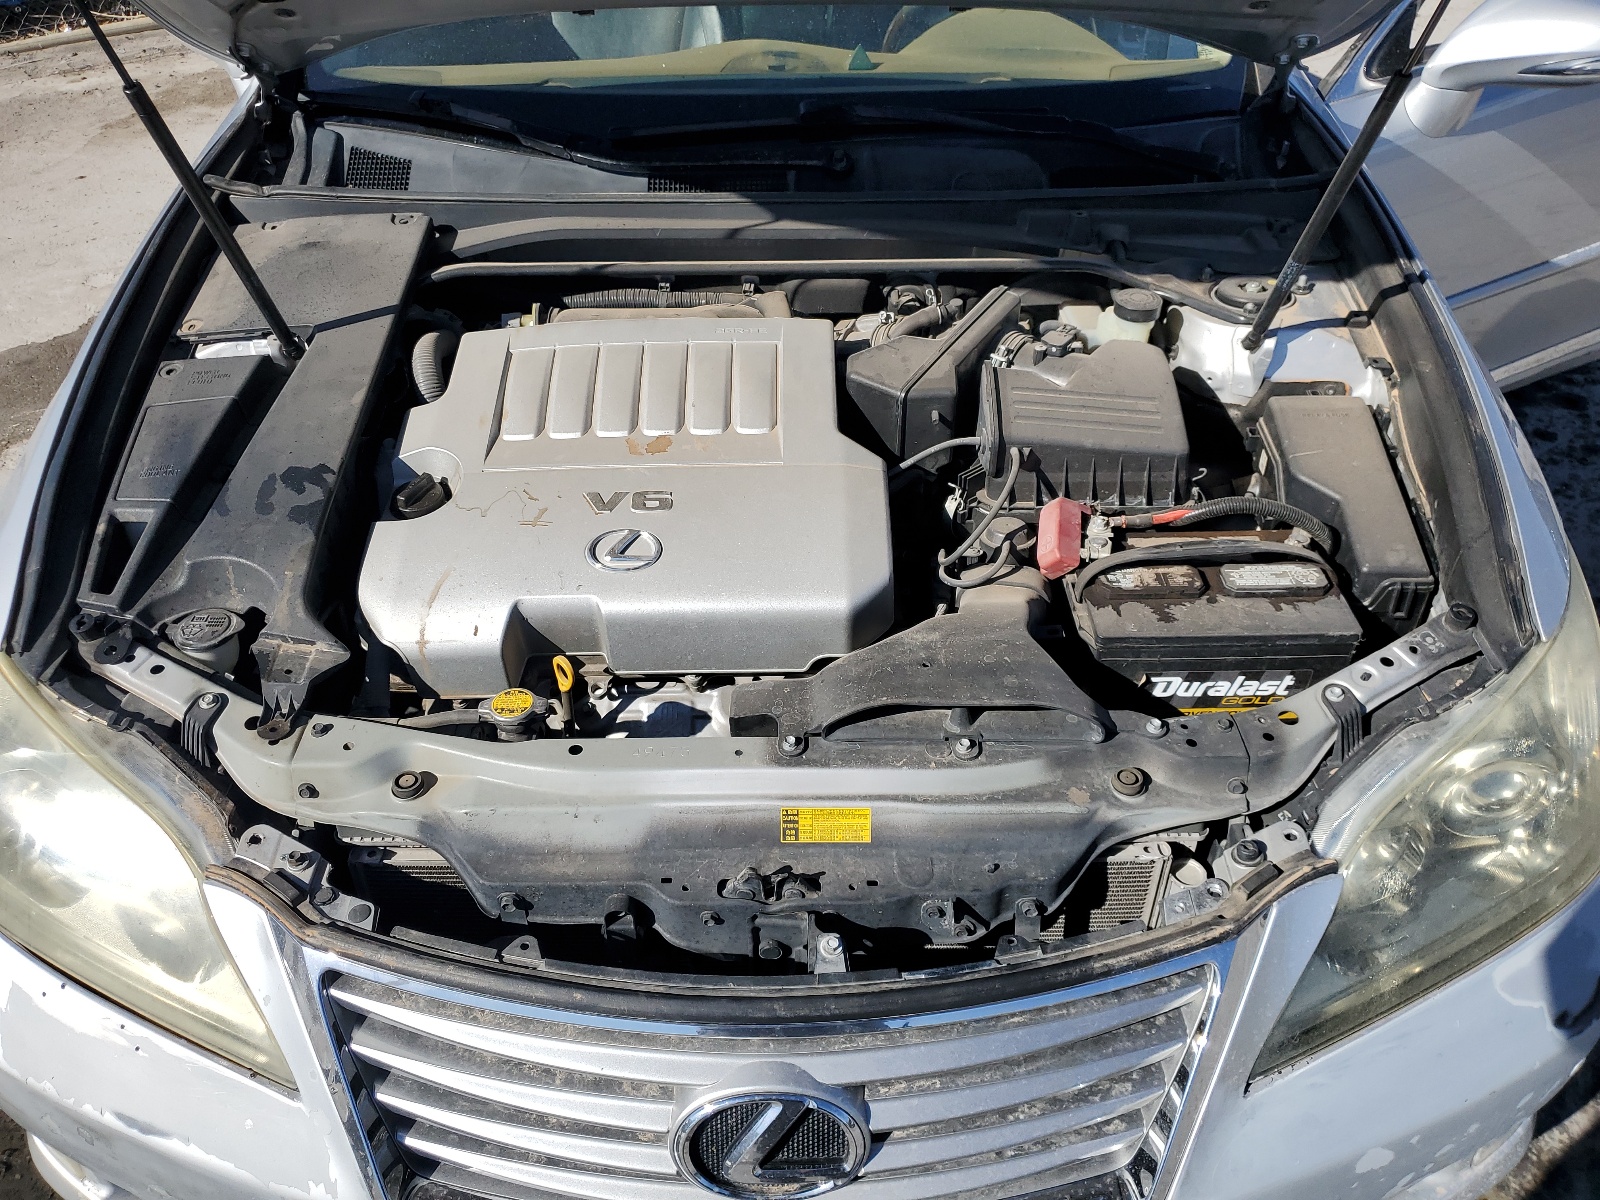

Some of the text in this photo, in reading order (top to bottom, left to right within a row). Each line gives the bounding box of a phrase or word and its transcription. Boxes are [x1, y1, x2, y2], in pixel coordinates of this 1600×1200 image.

[582, 489, 674, 514] V6
[1150, 675, 1295, 698] Duralast
[1221, 696, 1286, 705] GOLD
